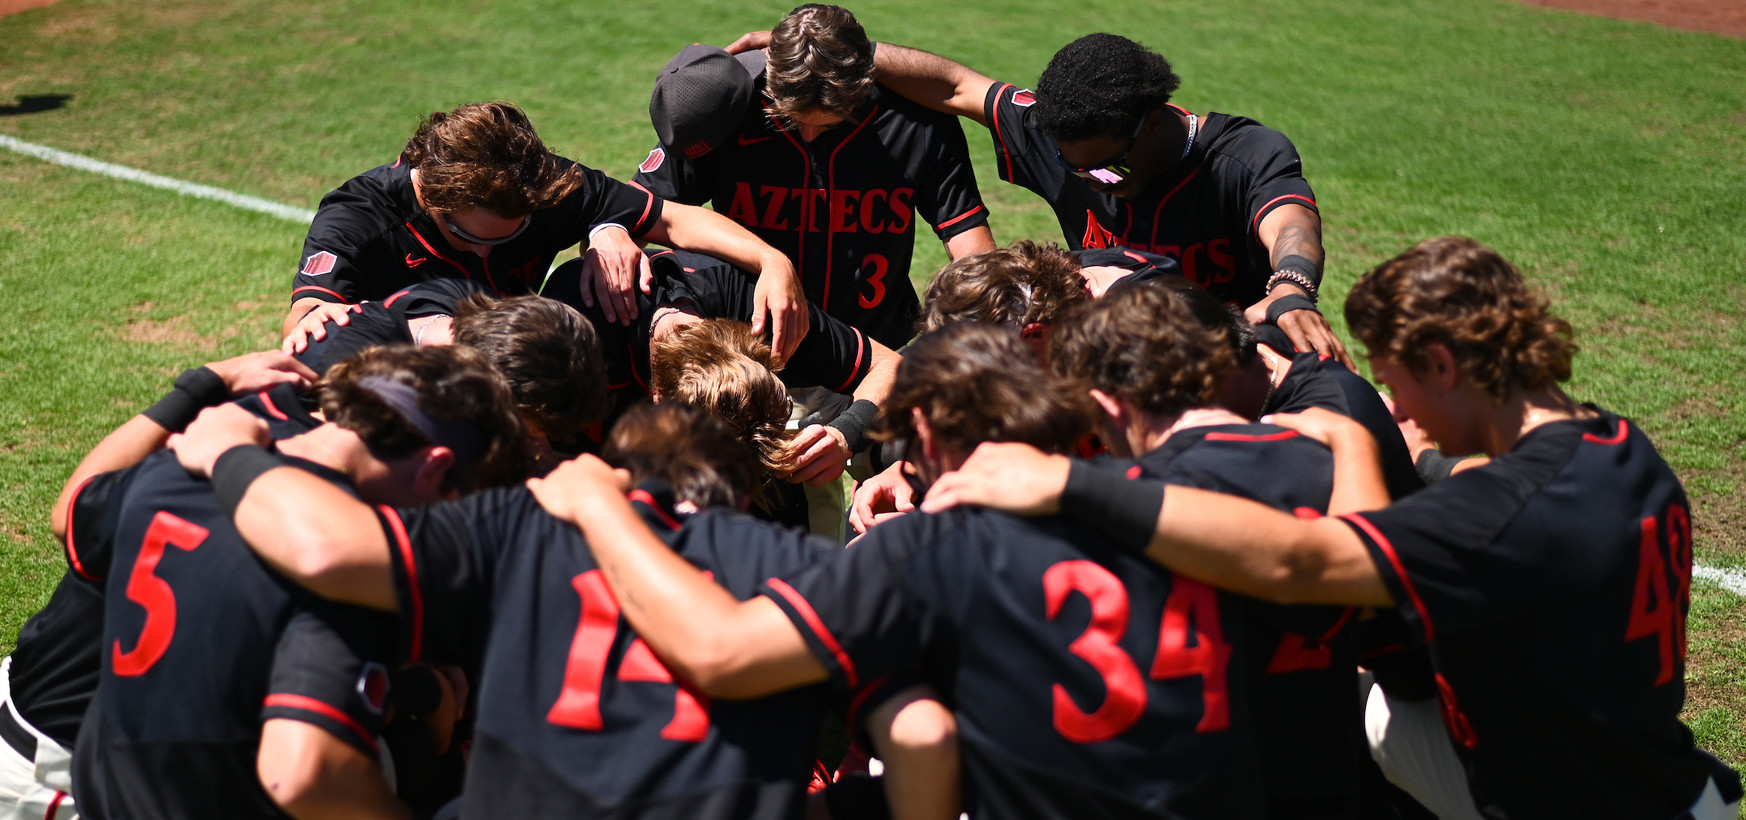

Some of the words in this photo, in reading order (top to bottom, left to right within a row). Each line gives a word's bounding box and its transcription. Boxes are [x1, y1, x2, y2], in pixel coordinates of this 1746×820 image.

[728, 180, 915, 235] AZTECS
[857, 252, 890, 310] 3
[1076, 208, 1237, 290] ACS
[111, 510, 211, 677] 5
[1042, 559, 1235, 744] 34
